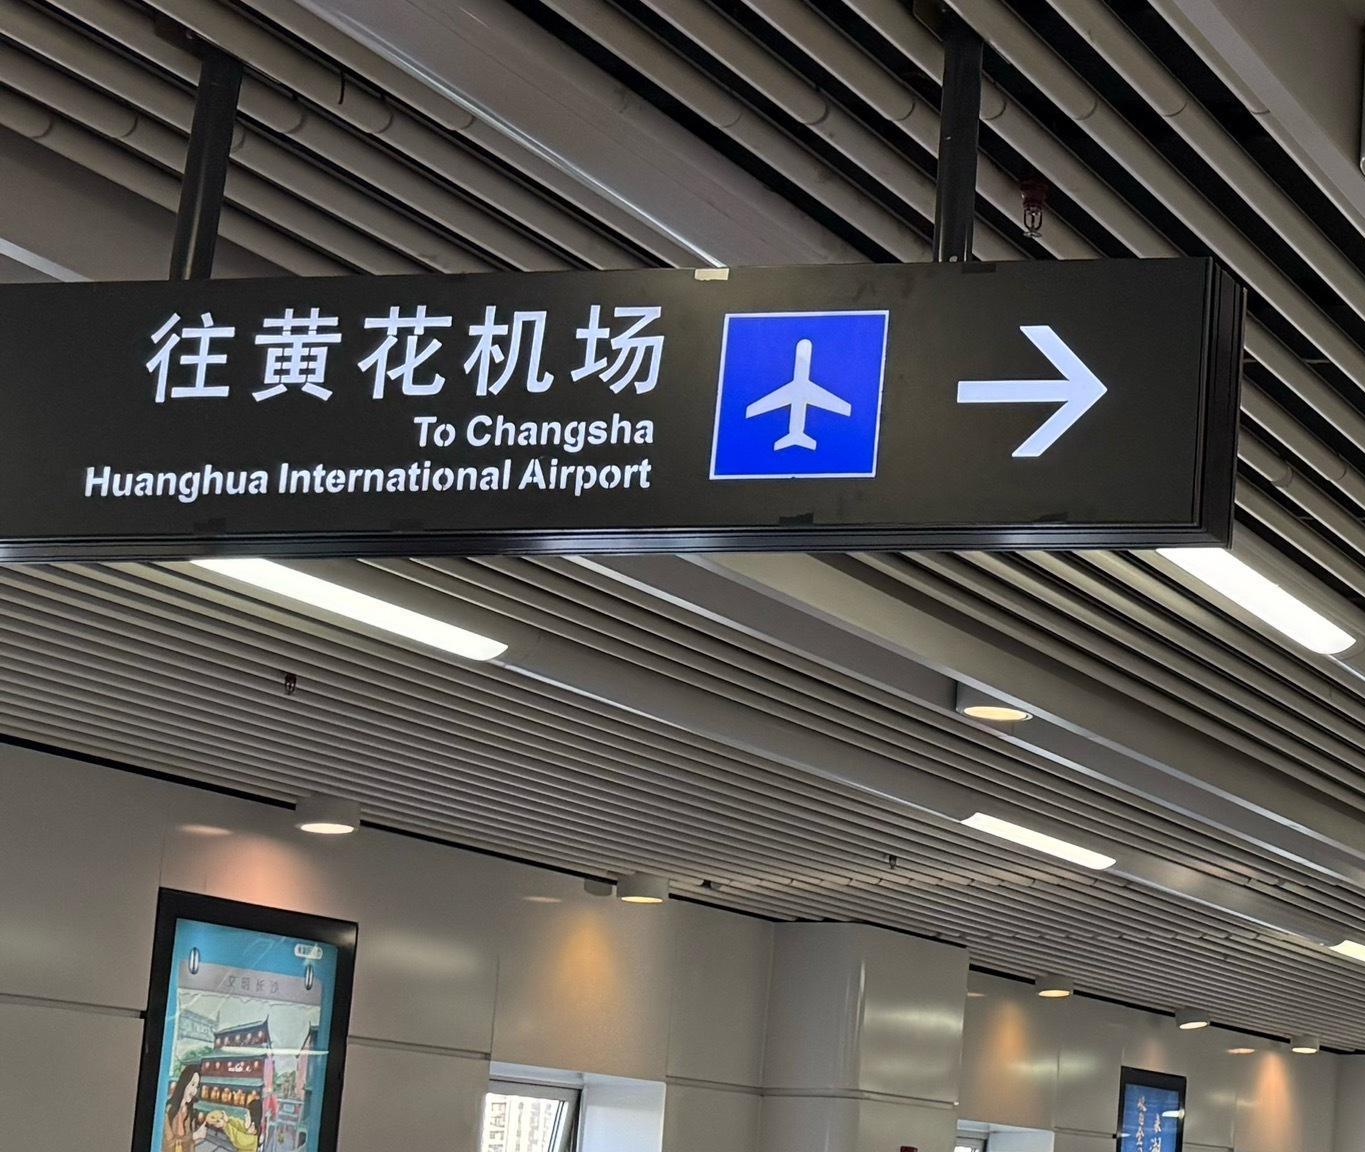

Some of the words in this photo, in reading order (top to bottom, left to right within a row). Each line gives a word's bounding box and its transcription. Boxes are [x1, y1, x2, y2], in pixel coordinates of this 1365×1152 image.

[145, 303, 665, 402] 往黄花机场
[413, 414, 455, 447] To
[466, 412, 655, 455] Changsha
[84, 463, 268, 503] Huanghua
[277, 459, 512, 495] International
[519, 455, 651, 497] Airport
